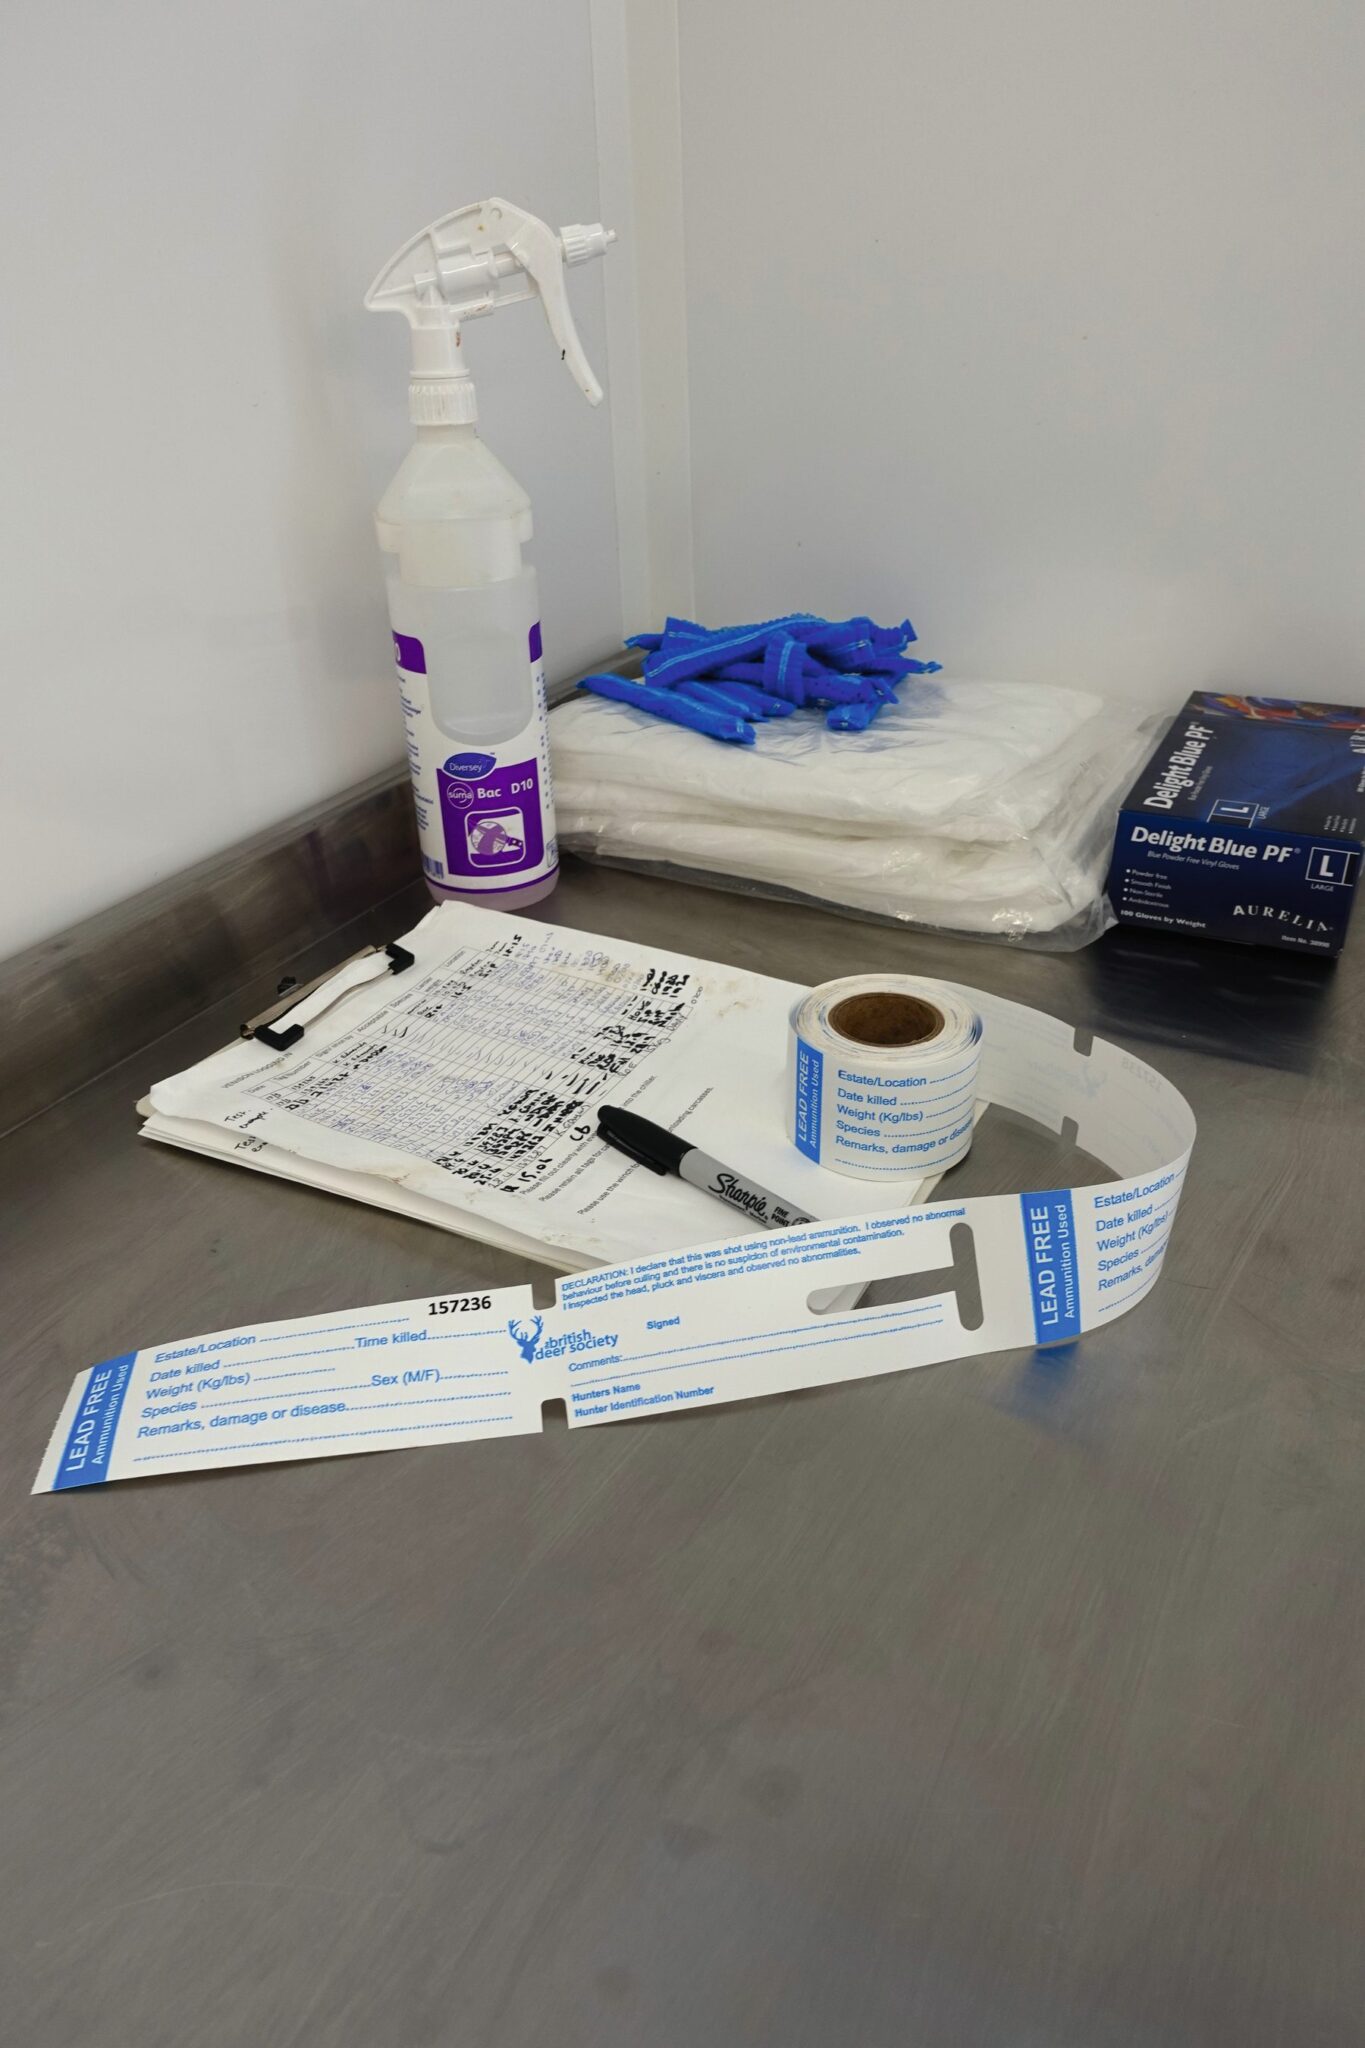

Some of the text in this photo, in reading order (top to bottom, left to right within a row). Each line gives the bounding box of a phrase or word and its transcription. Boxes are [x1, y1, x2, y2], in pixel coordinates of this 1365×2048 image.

[449, 762, 482, 773] Diversey
[1144, 764, 1194, 809] Delight
[1169, 739, 1206, 766] Blue
[477, 788, 502, 799] Bac
[511, 778, 534, 794] D10
[1220, 804, 1249, 814] L
[1131, 826, 1206, 853] Delight
[1208, 837, 1258, 859] Blue
[1147, 850, 1240, 870] Blue Powder Free Vinyl Gloves
[1319, 855, 1334, 877] L
[1310, 883, 1334, 892] LARGE
[1135, 911, 1162, 921] Gloves
[1163, 916, 1175, 924] by
[1175, 918, 1207, 929] Weight
[838, 1069, 927, 1088] Estate/Location
[798, 1051, 810, 1142] LEAD FREE
[809, 1060, 820, 1149] Ammunition Used
[837, 1088, 897, 1106] Date killed
[836, 1104, 924, 1125] Weight (Kg/lbs)
[836, 1120, 881, 1137] Species
[835, 1135, 949, 1154] Remarks, damage or
[606, 1182, 620, 1192] the
[615, 1168, 634, 1183] winch
[1094, 1173, 1175, 1209] Estate/Location
[708, 1173, 767, 1217] Sharpie
[771, 1213, 790, 1227] POINT
[774, 1206, 790, 1218] FINE
[1096, 1204, 1153, 1232] Date killed
[1096, 1211, 1168, 1252] Weight (Kg/lbs)
[562, 1269, 628, 1291] DECLARATION:
[635, 1261, 667, 1274] declare
[669, 1256, 686, 1268] that
[687, 1252, 703, 1264] this
[704, 1249, 722, 1258] was
[724, 1245, 742, 1256] shot
[744, 1240, 768, 1253] using
[769, 1231, 807, 1247] non-lead
[808, 1224, 861, 1240] ammunition.
[871, 1214, 911, 1230] observed
[912, 1214, 924, 1223] no
[925, 1207, 966, 1221] abnormal
[1054, 1204, 1075, 1319] Ammunition Used
[1097, 1249, 1139, 1272] Species
[562, 1228, 905, 1301] behaviour before culling and there is no suspicion of environmental contamination.
[568, 1293, 609, 1310] inspected
[610, 1289, 624, 1301] the
[625, 1284, 651, 1297] head,
[651, 1279, 675, 1293] pluck
[676, 1275, 693, 1286] and
[695, 1269, 726, 1282] viscera
[727, 1265, 744, 1276] and
[746, 1257, 786, 1273] observed
[788, 1255, 800, 1265] no
[801, 1246, 862, 1263] abnormalities.
[1030, 1206, 1060, 1326] LEAD FREE
[1098, 1263, 1143, 1291] Remarks,
[428, 1295, 492, 1316] 157236
[646, 1316, 681, 1330] Signed
[154, 1334, 257, 1364] Estate/Location
[535, 1345, 566, 1361] deer
[570, 1334, 619, 1353] society
[550, 1328, 592, 1349] british
[150, 1329, 428, 1383] Date killed Time killed
[141, 1368, 441, 1420] Species Sex (M/F)
[146, 1372, 251, 1400] Weight (Kg/lbs)
[572, 1382, 641, 1403] Hunters Name
[91, 1364, 130, 1465] Ammunition Used
[574, 1386, 715, 1418] Hunter Identification Number
[66, 1368, 113, 1472] LEAD FREE
[137, 1402, 346, 1439] Remarks, damage or disease
